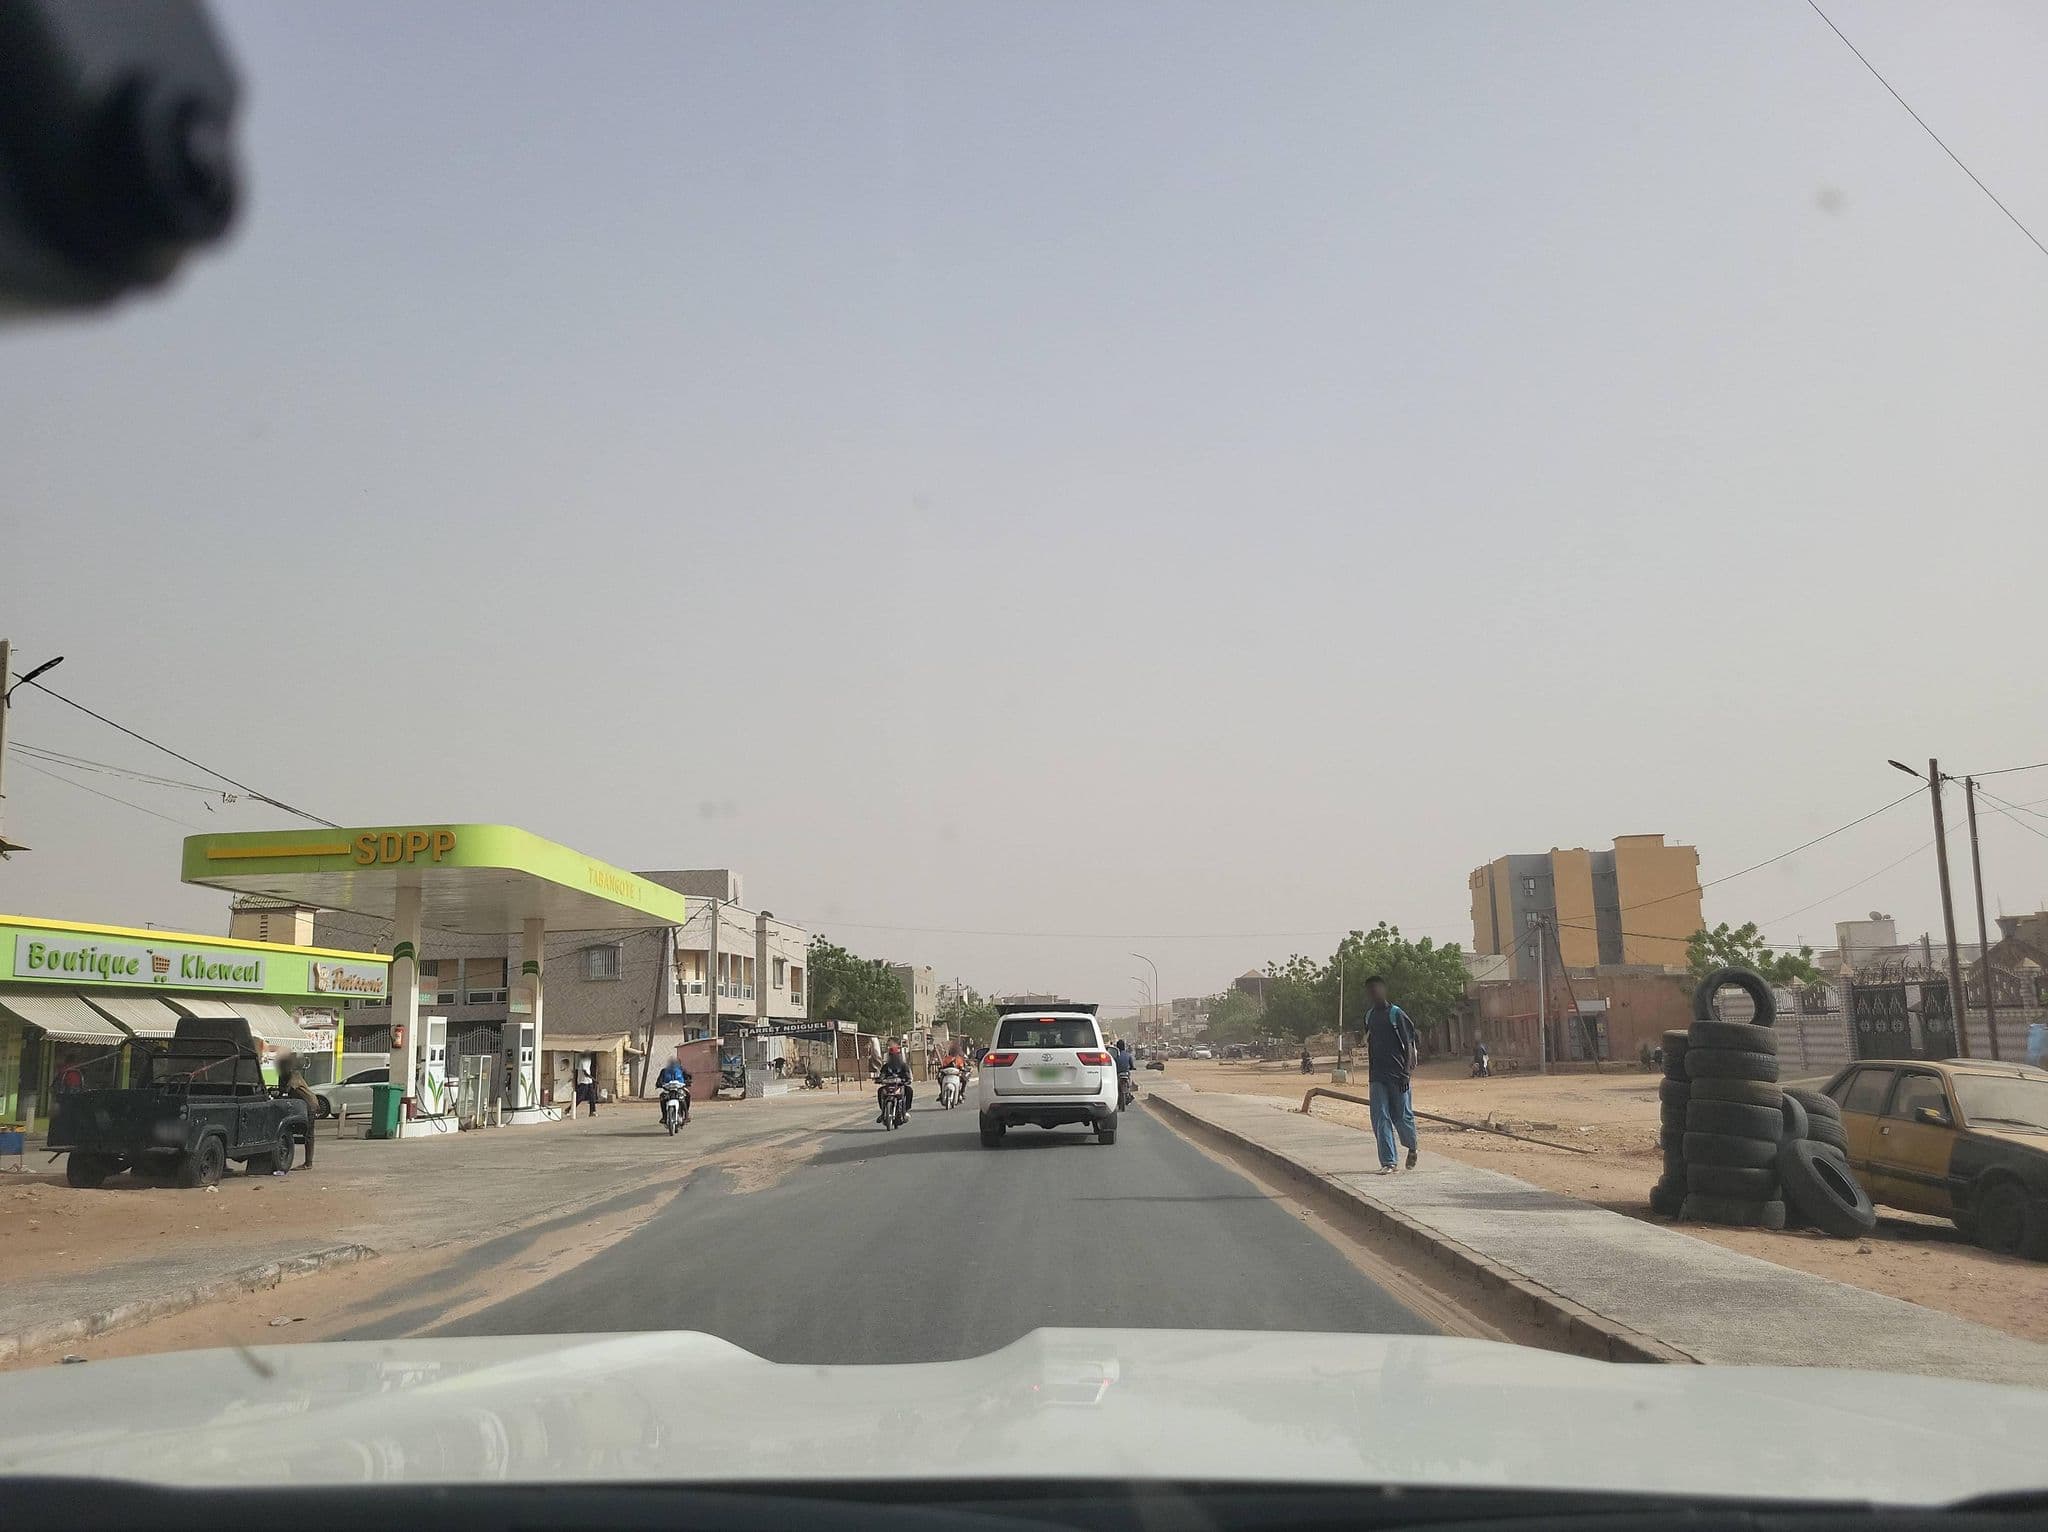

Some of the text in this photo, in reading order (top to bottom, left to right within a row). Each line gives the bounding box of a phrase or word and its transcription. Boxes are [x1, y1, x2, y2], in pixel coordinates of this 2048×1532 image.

[355, 831, 456, 865] SDPP
[29, 942, 261, 983] Boutique Kheweul
[783, 1022, 826, 1032] NDIGUEL
